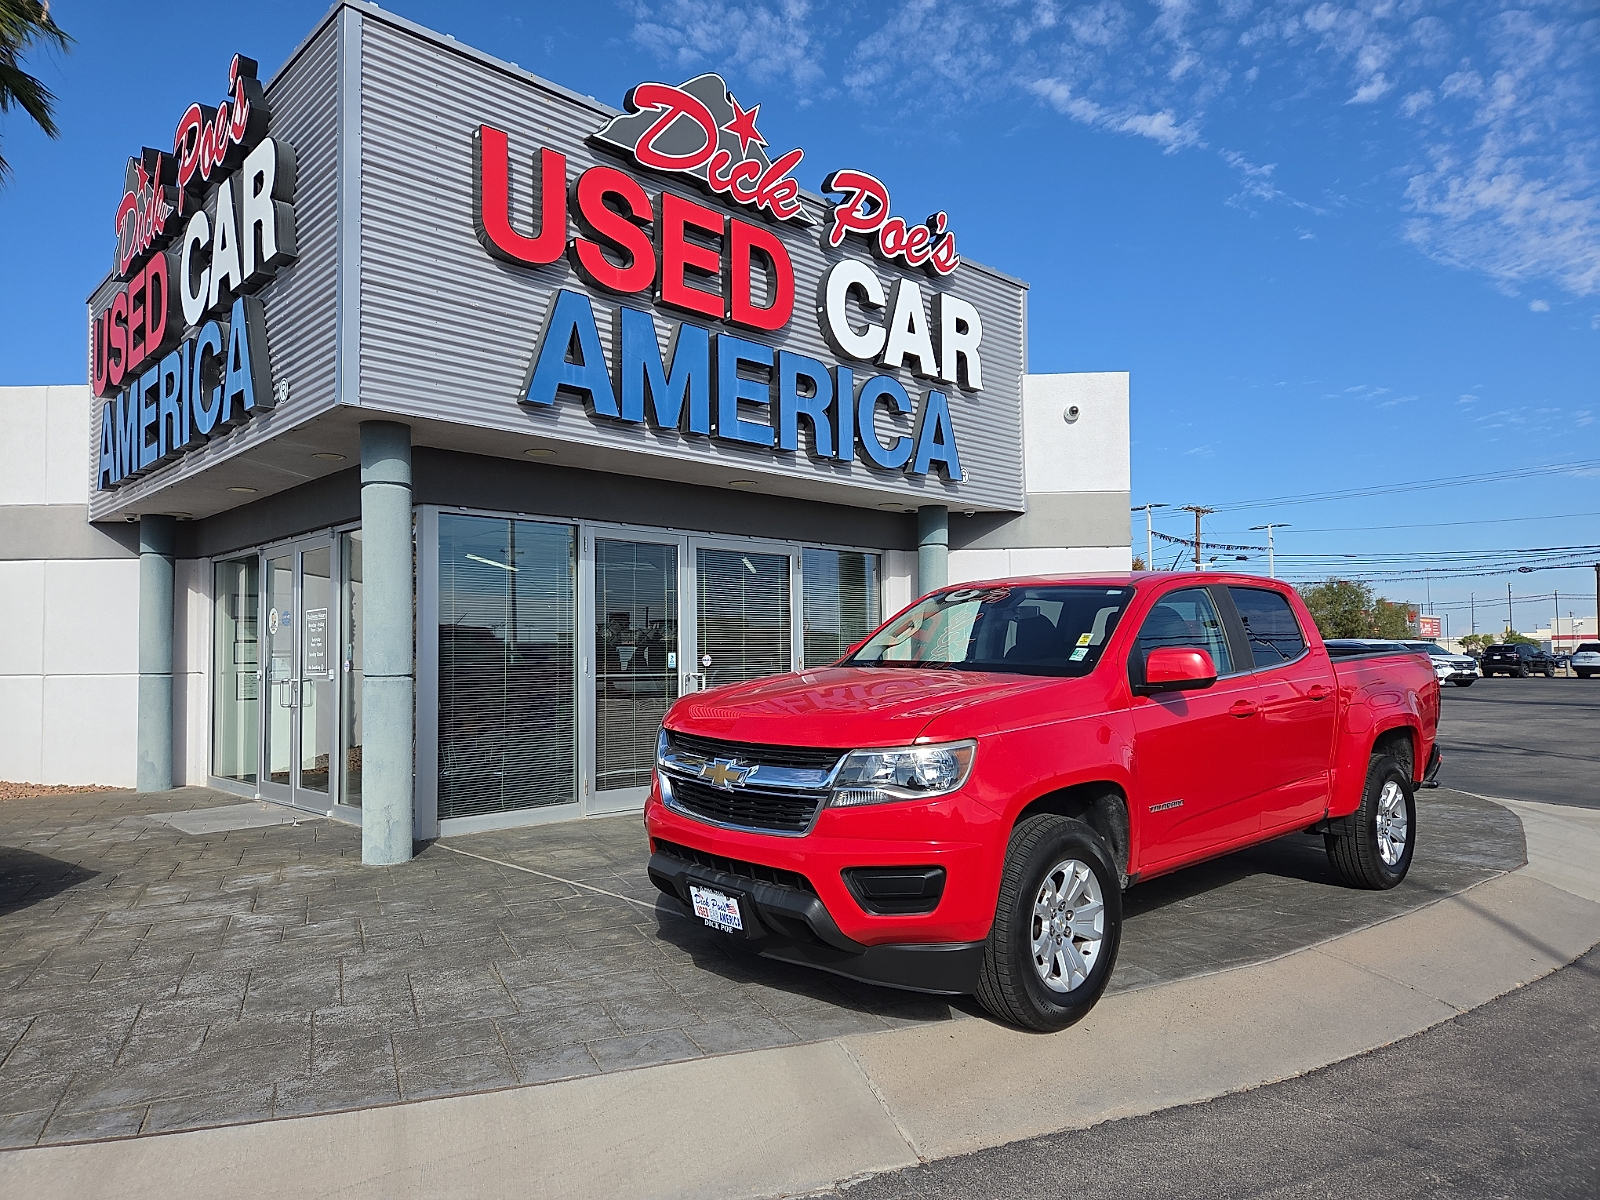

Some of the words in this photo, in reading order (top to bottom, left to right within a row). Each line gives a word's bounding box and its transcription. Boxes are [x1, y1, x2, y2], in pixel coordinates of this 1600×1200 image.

[114, 150, 168, 267] Dick
[174, 53, 249, 214] Poe's
[478, 123, 796, 331] USED
[824, 258, 985, 392] CAR
[631, 81, 806, 221] Dick
[825, 167, 961, 276] Poe's
[93, 251, 168, 398] USED
[180, 136, 278, 328] CAR
[97, 296, 256, 491] AMERICA
[523, 288, 964, 482] AMERICA
[694, 894, 710, 907] Dick
[705, 919, 720, 929] DICK
[720, 924, 733, 933] POE
